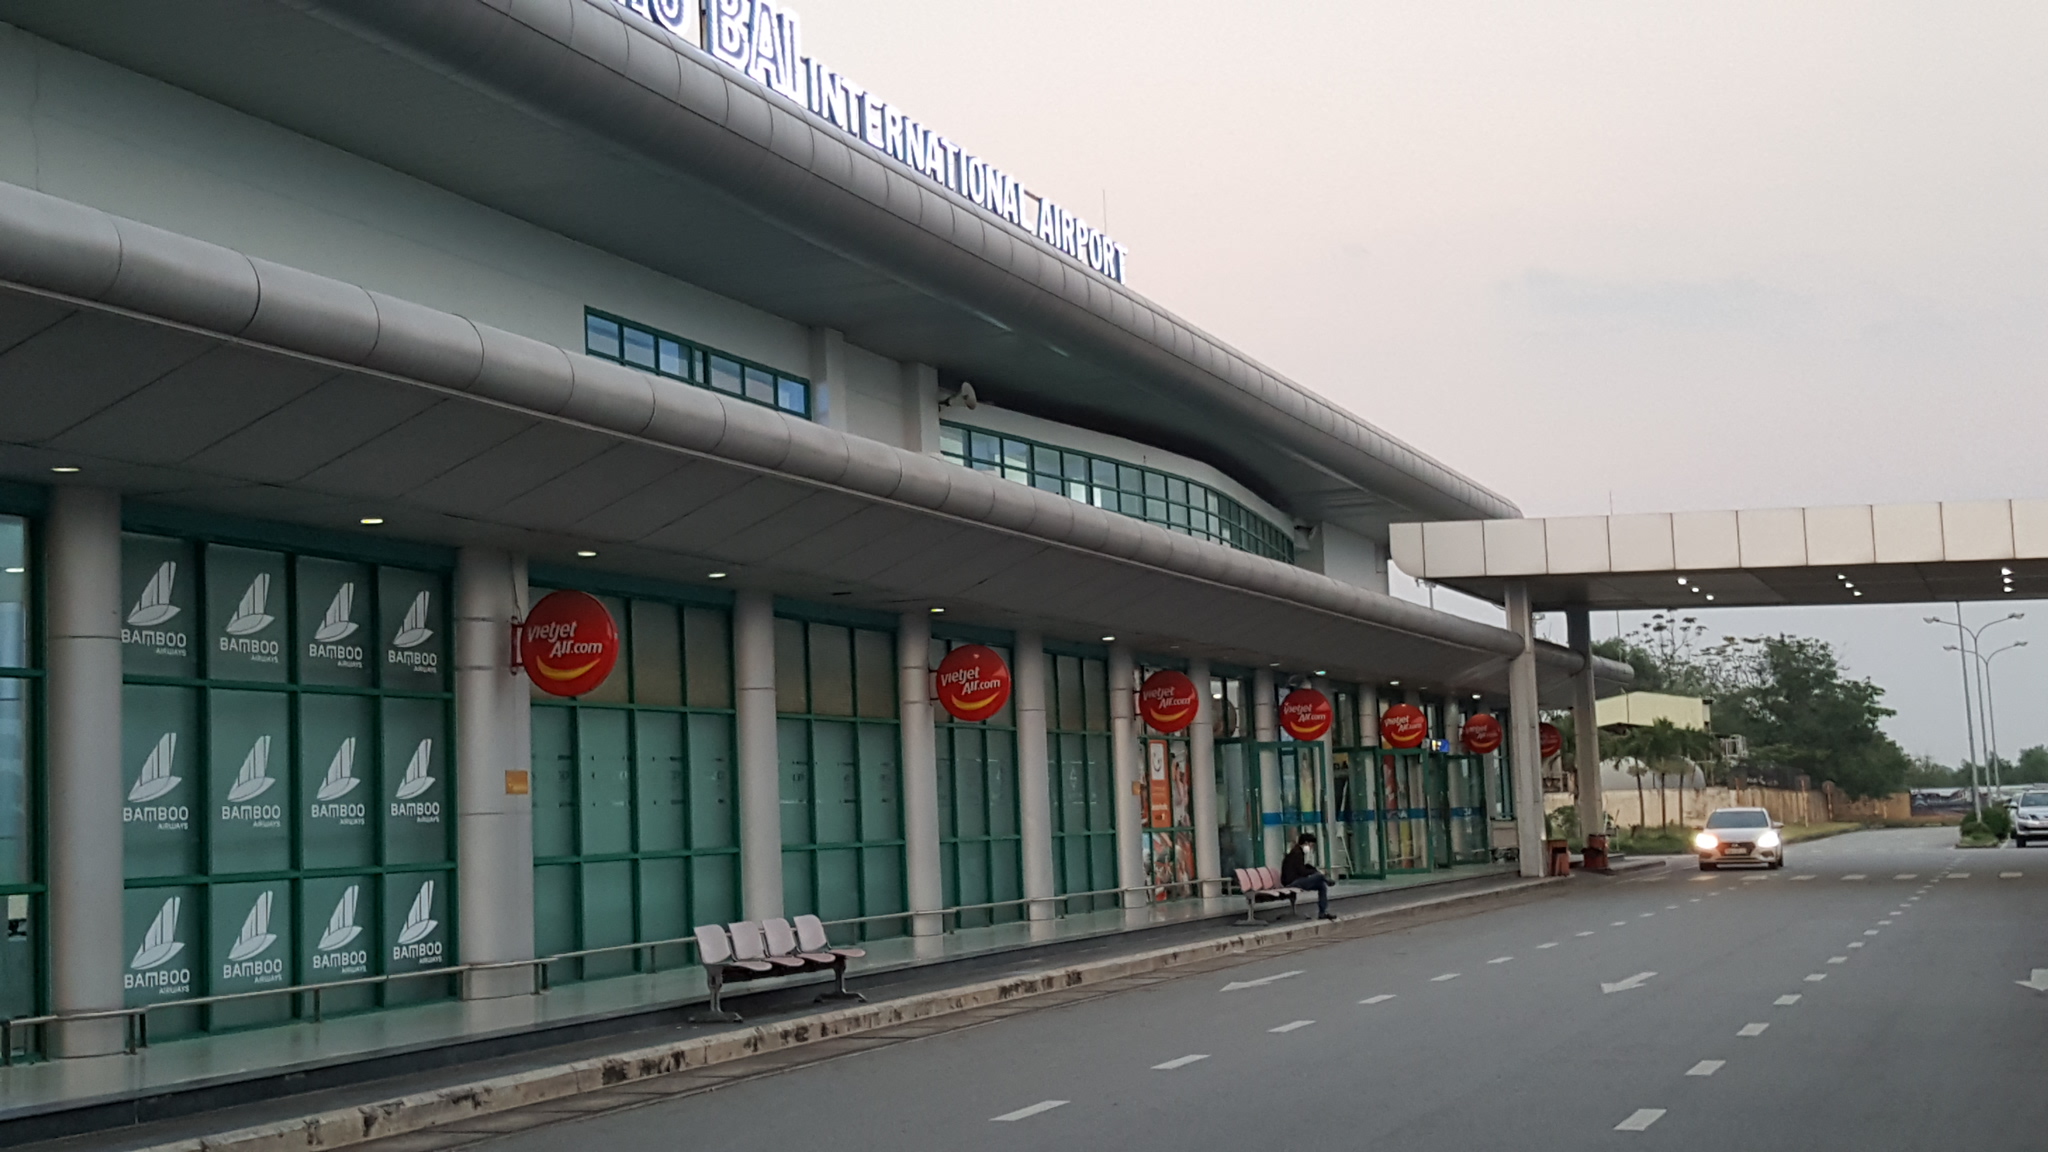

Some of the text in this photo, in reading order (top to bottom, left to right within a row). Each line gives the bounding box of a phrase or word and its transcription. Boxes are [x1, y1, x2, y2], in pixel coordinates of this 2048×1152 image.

[707, 0, 1129, 285] BAI INTERNATIONAL AIRPORT
[120, 628, 187, 648] BAMBOO
[219, 637, 279, 655] BAMBOO
[156, 647, 187, 657] AIRWAYS
[309, 643, 363, 660] BAMBOO
[388, 649, 437, 666] BAMBOO
[549, 640, 603, 658] Air.com
[123, 806, 189, 823] BAMBOO
[222, 805, 281, 821] BAMBOO
[311, 803, 365, 818] BAMBOO
[390, 802, 440, 817] BAMBOO
[157, 822, 189, 831] AIRWAYS
[312, 950, 367, 969] BAMBOO
[393, 941, 442, 961] BAMBOO
[223, 958, 283, 979] BAMBOO
[124, 968, 190, 989] BAMBOO
[159, 984, 190, 995] AIRWAYS
